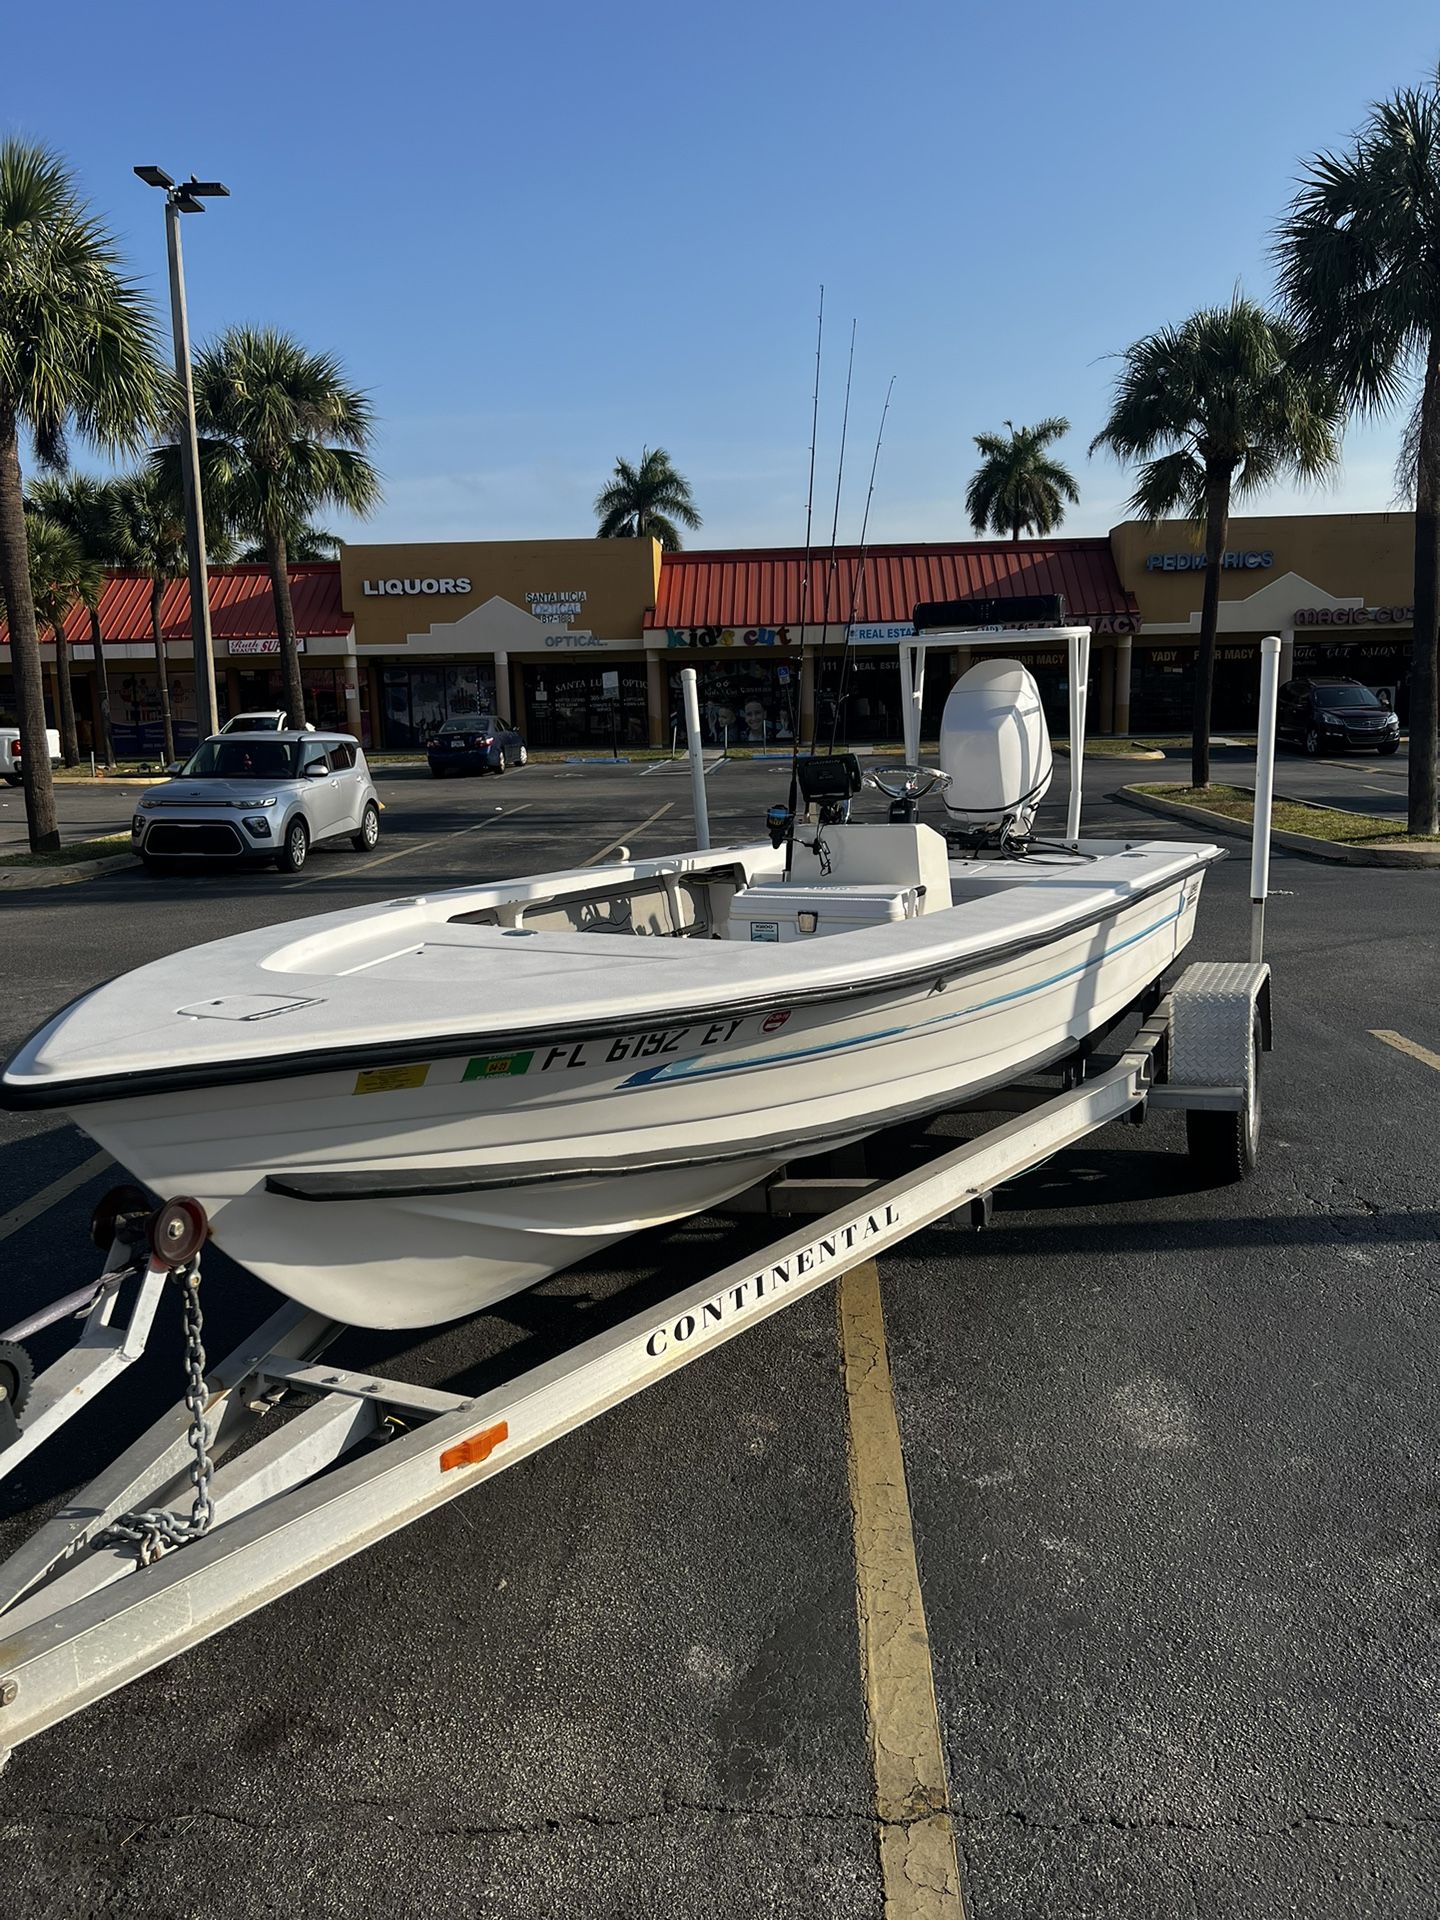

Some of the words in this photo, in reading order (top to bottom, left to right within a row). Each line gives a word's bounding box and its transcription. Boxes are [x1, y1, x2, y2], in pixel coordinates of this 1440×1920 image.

[1147, 551, 1274, 571] PEDIARICS
[363, 577, 472, 596] LIQUORS
[526, 592, 555, 603] SANTA
[558, 591, 586, 602] LUCIA
[1294, 608, 1370, 625] MAGIC
[1375, 606, 1415, 623] CU
[665, 626, 736, 649] kid's
[743, 626, 792, 648] cut
[859, 629, 884, 639] REAL
[261, 639, 302, 652] SUPY
[1359, 646, 1398, 658] SALON
[1036, 653, 1065, 665] MACY
[1151, 650, 1178, 662] YADY
[1224, 648, 1255, 660] MACY
[554, 679, 586, 693] SANTA
[541, 1043, 587, 1071] FL
[605, 1028, 690, 1063] 6192
[701, 1018, 745, 1046] EY
[645, 1203, 900, 1358] CONTINENTAL
